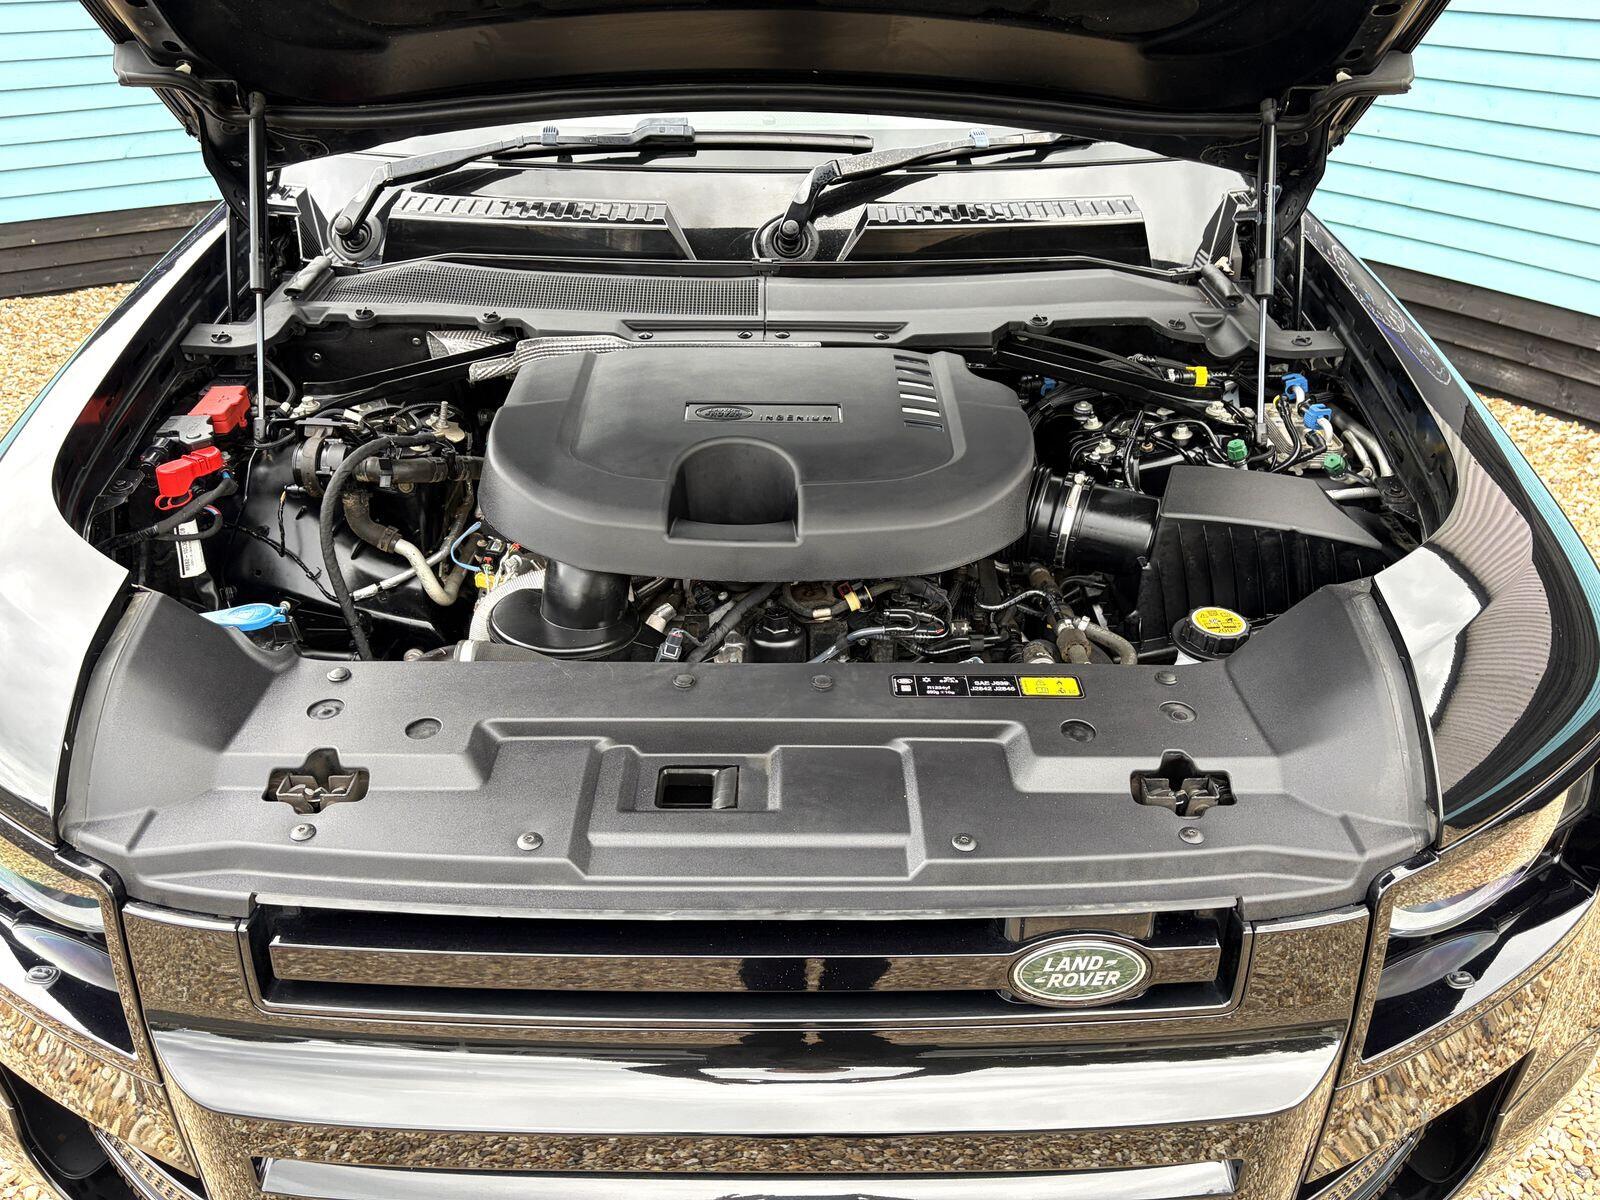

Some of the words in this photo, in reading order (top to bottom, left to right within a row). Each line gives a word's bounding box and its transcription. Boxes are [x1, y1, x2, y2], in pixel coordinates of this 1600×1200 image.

[759, 414, 833, 422] INGENIUM
[1043, 955, 1104, 972] LAND
[1046, 970, 1121, 988] ROVER
